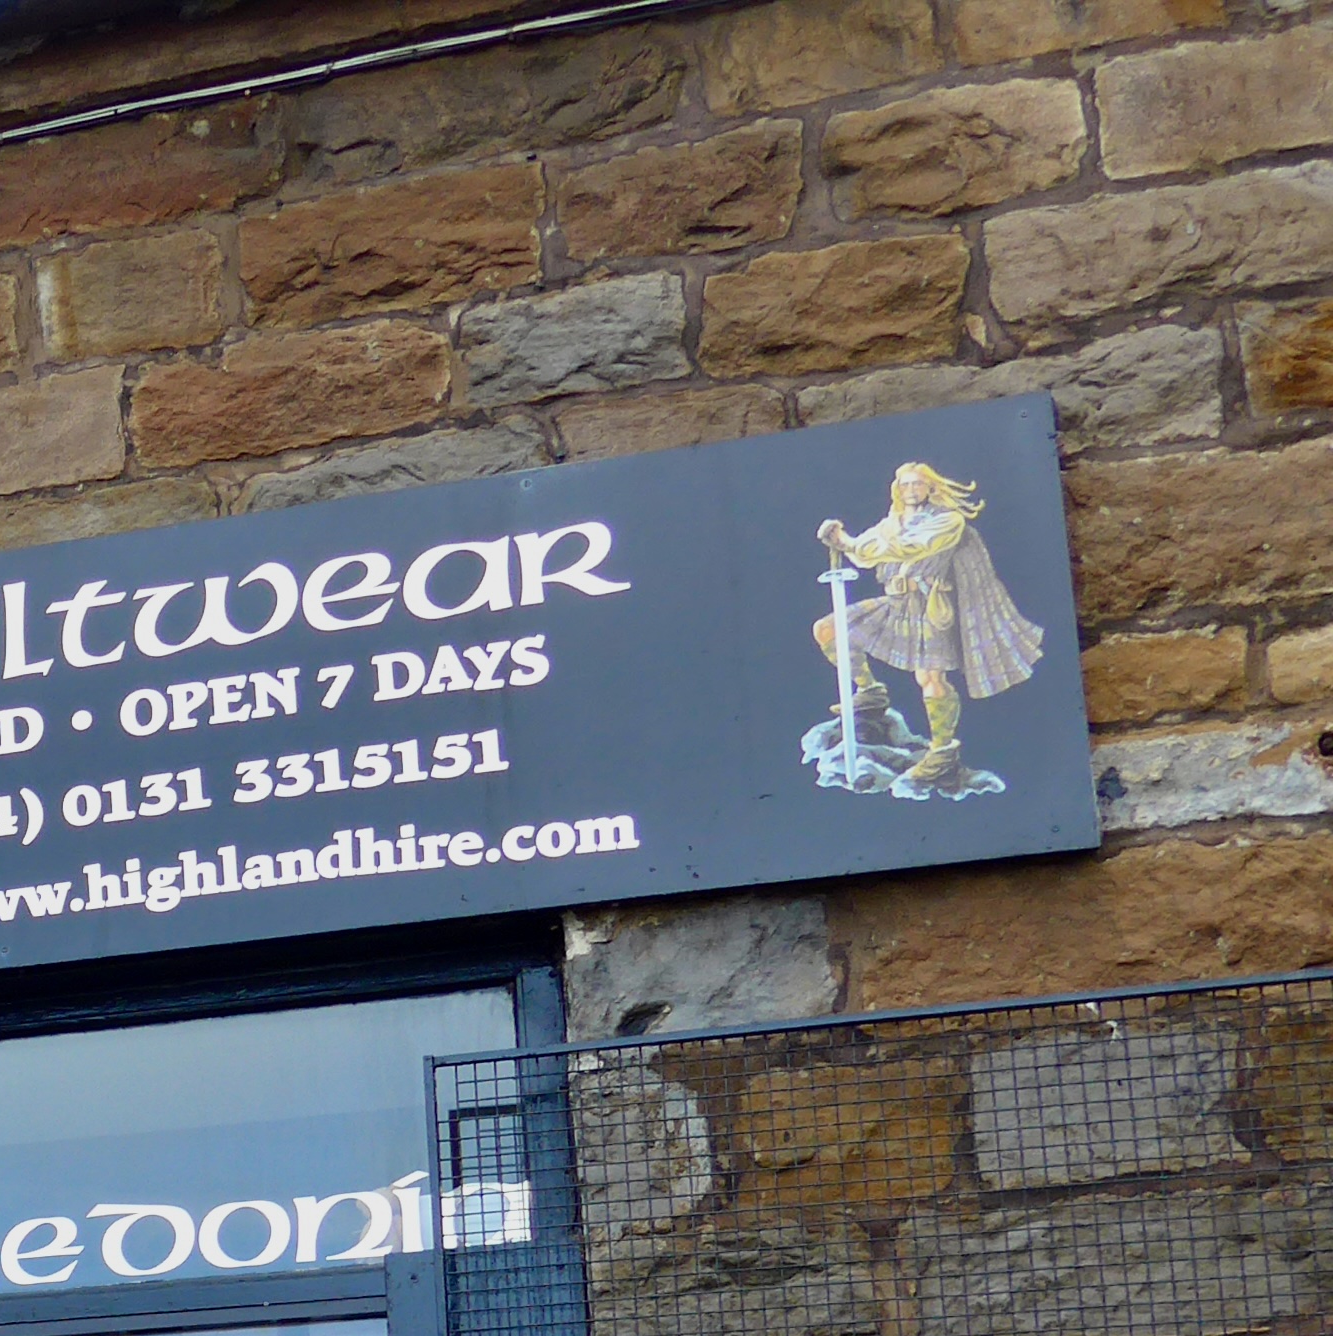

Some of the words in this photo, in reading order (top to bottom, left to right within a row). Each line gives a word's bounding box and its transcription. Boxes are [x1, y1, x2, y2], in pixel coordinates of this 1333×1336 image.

[120, 667, 300, 737] OPEN
[316, 664, 354, 708] 7
[371, 634, 550, 701] DAYS
[62, 768, 213, 827] 0131
[233, 729, 509, 803] 3315151
